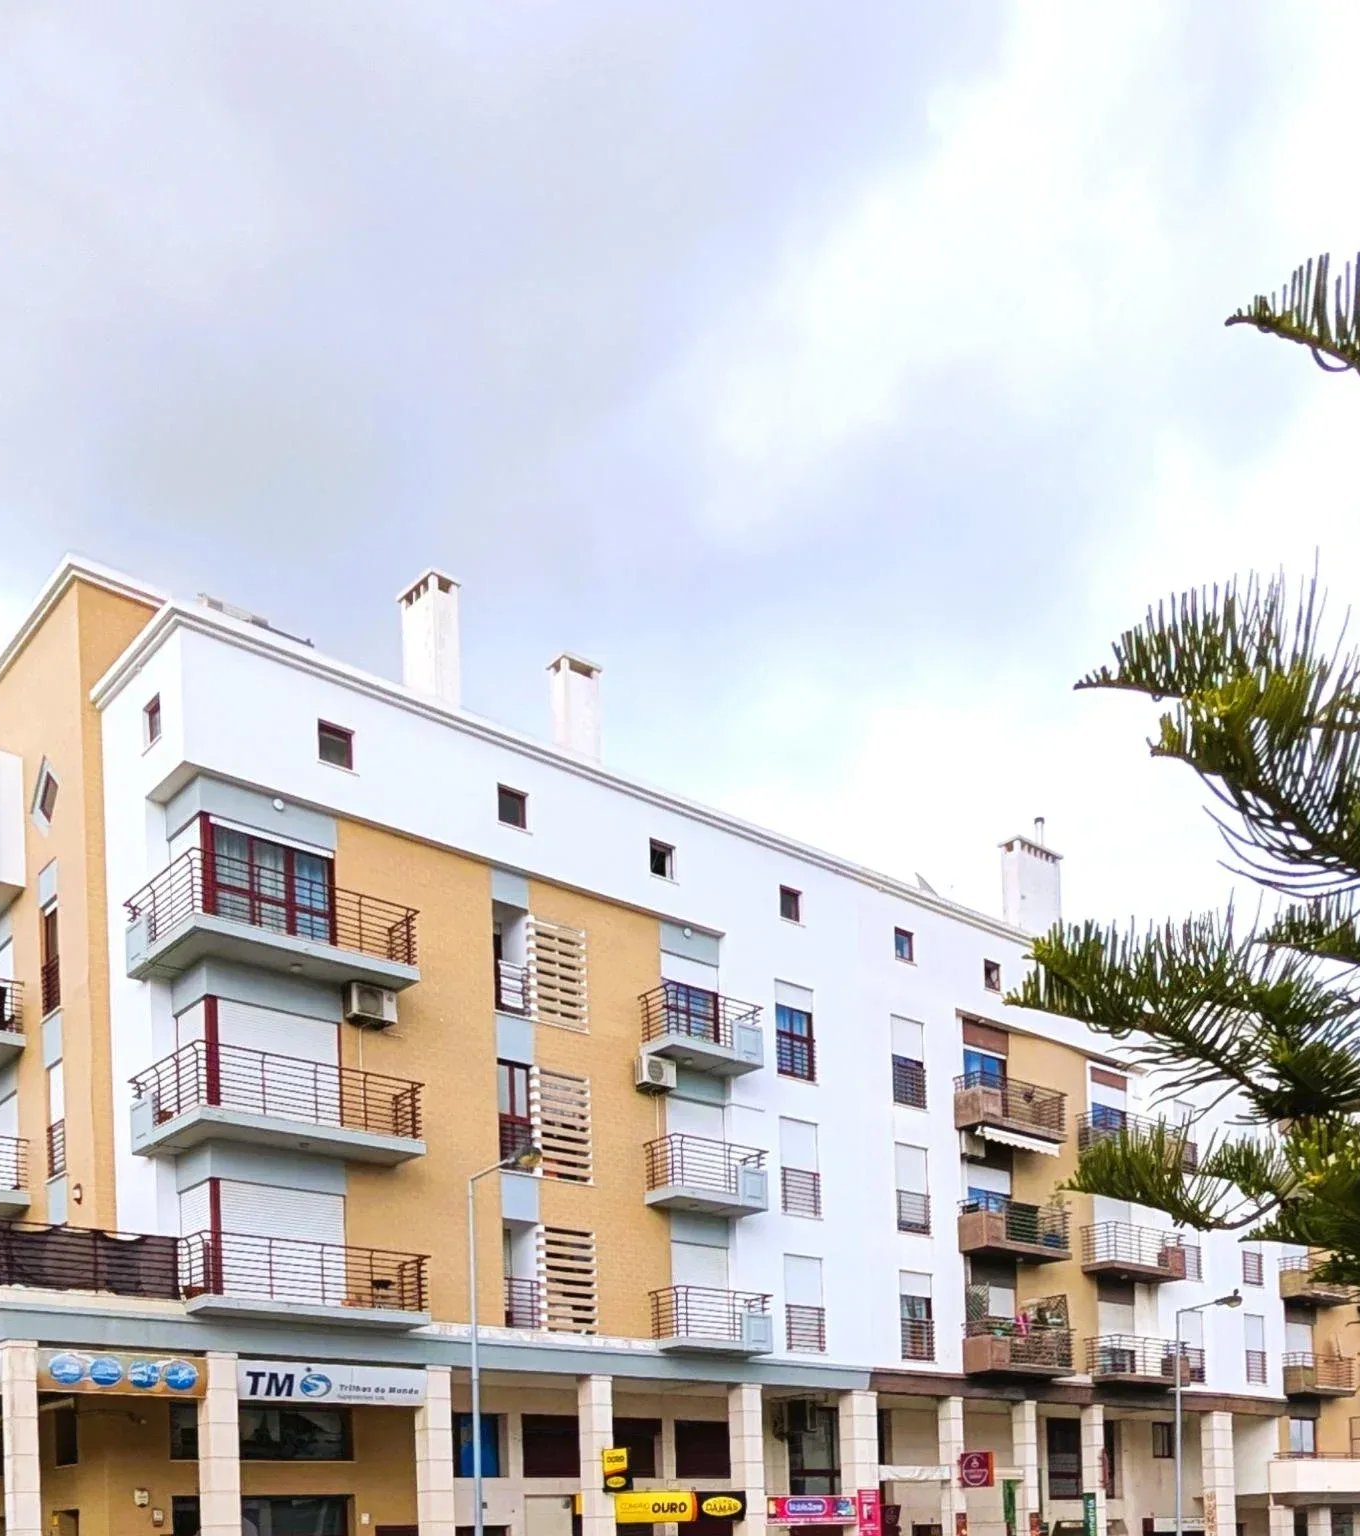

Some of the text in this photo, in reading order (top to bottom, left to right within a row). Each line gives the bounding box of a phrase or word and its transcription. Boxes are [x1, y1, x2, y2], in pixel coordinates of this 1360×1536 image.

[246, 1371, 294, 1397] TM
[651, 1502, 688, 1514] OURO
[706, 1503, 739, 1513] DAMAS
